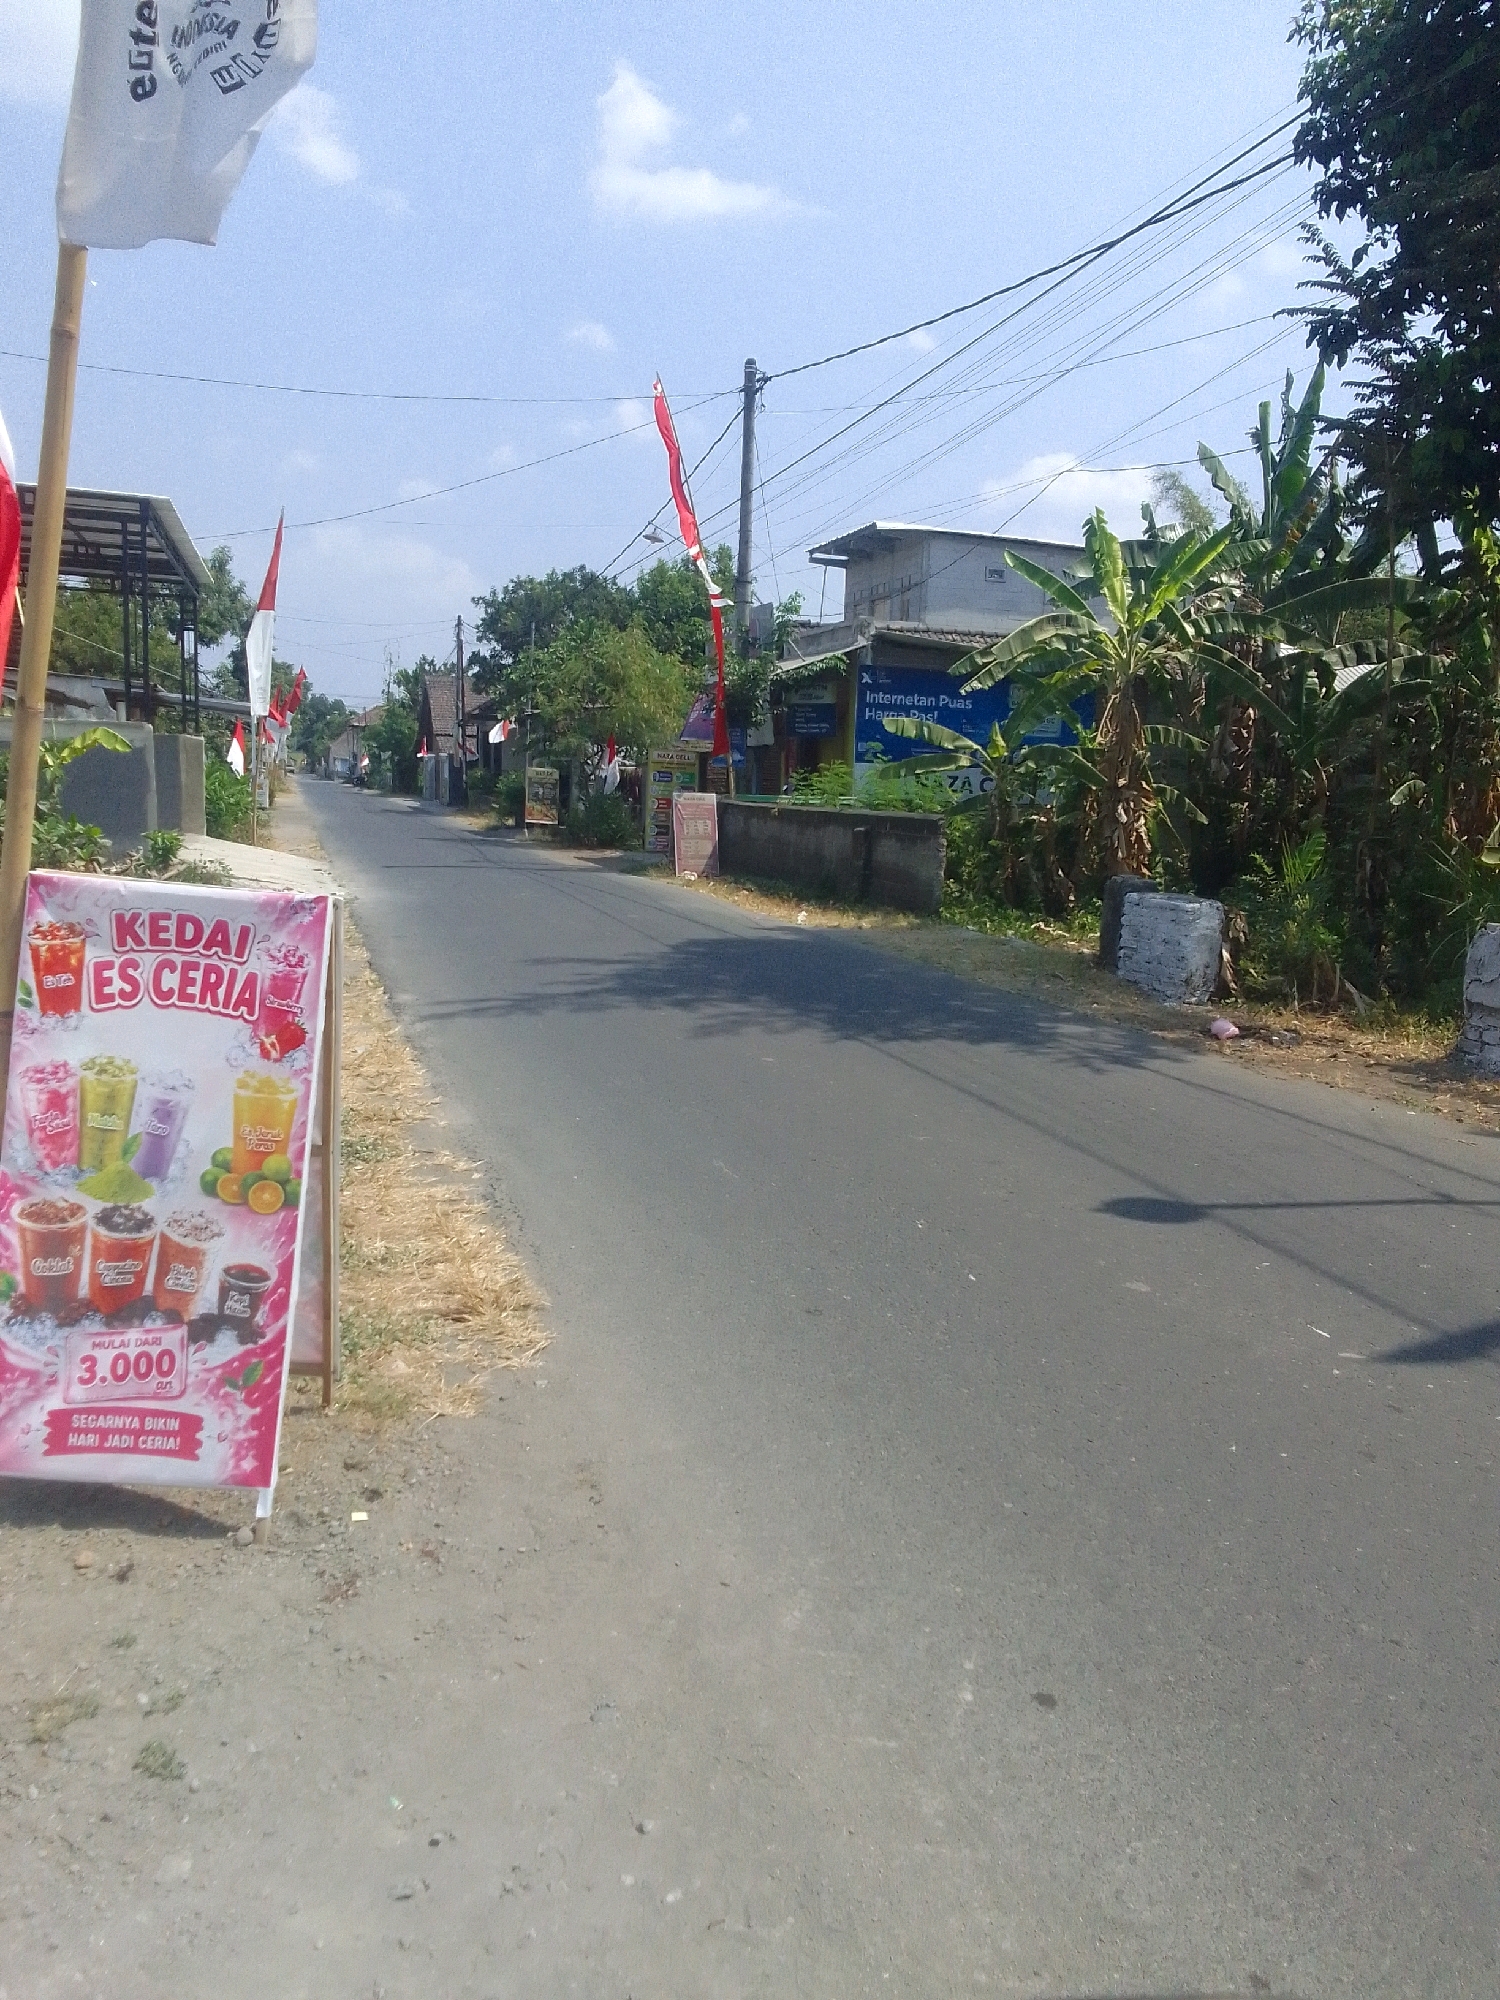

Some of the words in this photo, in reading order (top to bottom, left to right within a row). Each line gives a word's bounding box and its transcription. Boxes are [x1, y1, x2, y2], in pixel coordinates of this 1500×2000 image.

[866, 691, 936, 707] Internetan
[939, 695, 973, 709] Puas
[112, 910, 254, 961] KEDAI
[91, 957, 142, 1008] ES
[150, 957, 261, 1019] CERIA
[31, 1257, 75, 1275] Coklat
[91, 1338, 133, 1351] MULAI
[135, 1336, 163, 1349] DARI
[77, 1349, 176, 1387] 3.000
[71, 1414, 141, 1430] SEGARNYA
[145, 1416, 179, 1431] BIKIN
[68, 1434, 99, 1448] HARI
[104, 1434, 134, 1449] JADI
[138, 1435, 180, 1450] CERIA!
